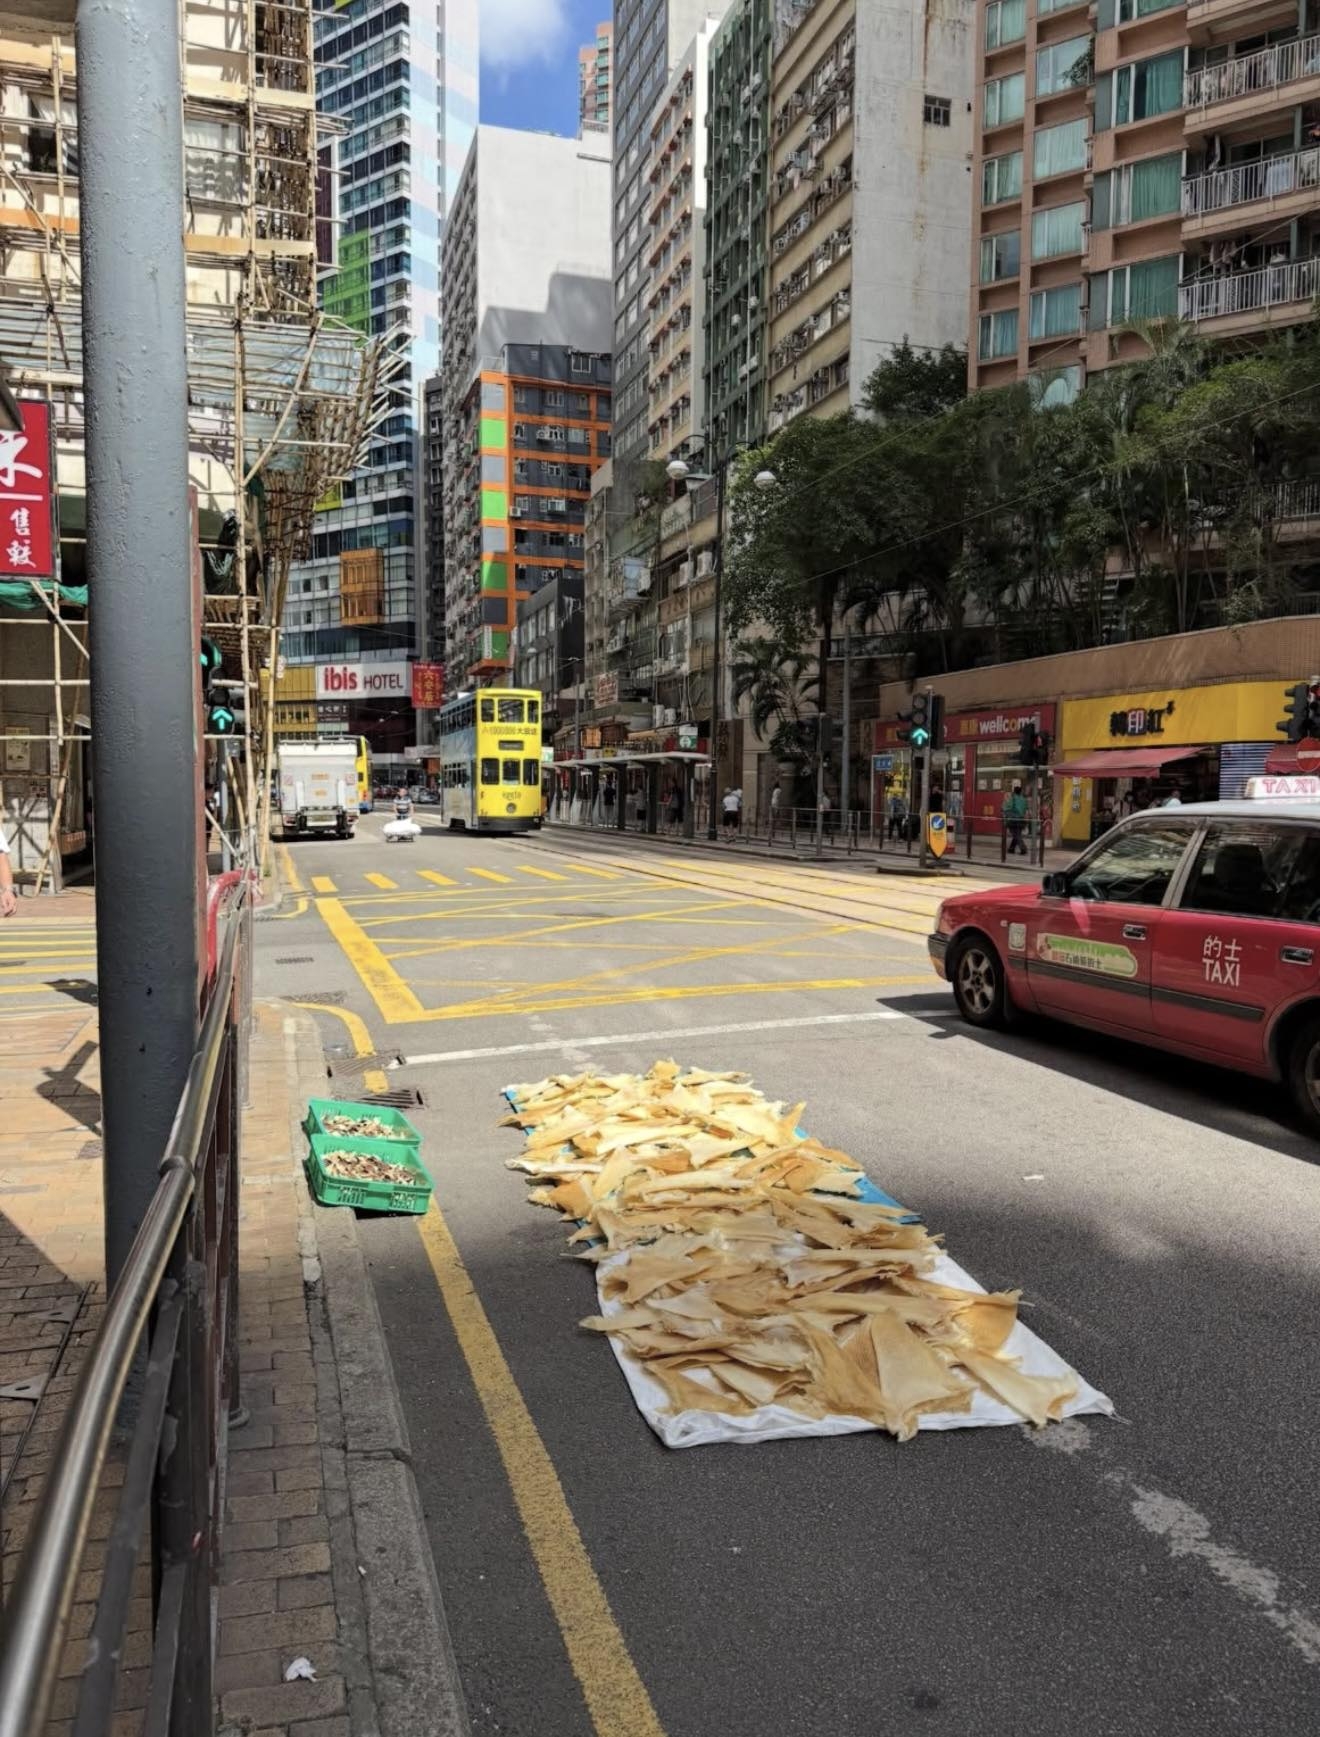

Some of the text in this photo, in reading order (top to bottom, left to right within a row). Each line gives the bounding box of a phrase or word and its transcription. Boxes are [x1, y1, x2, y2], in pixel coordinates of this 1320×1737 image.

[324, 666, 358, 691] ibis
[364, 673, 404, 690] HOTEL
[1262, 778, 1316, 793] TAXI
[1203, 935, 1243, 961] 的士
[1202, 957, 1241, 987] TAXI
